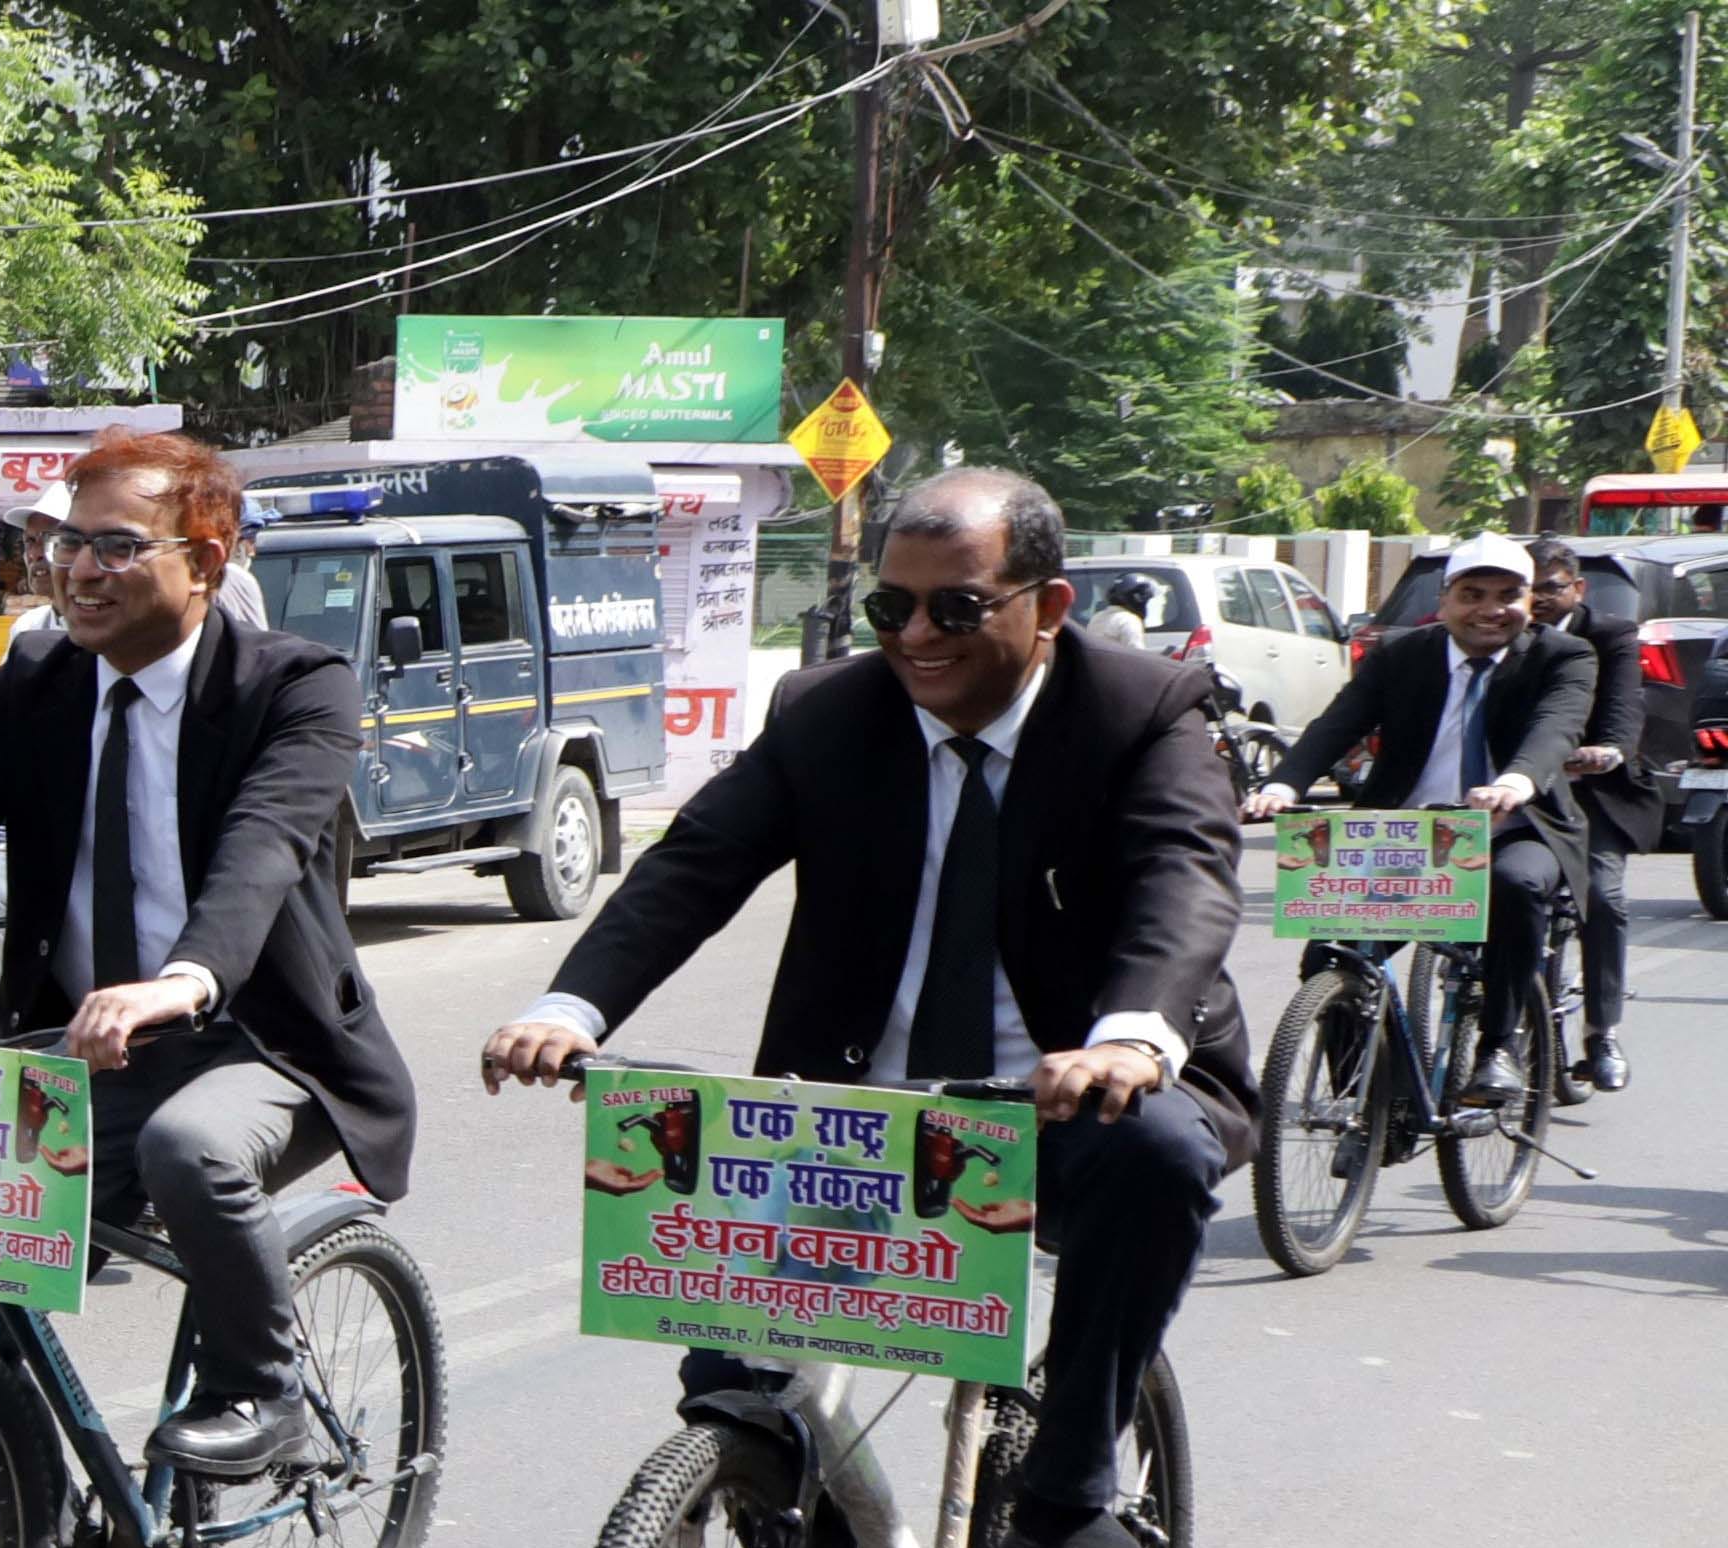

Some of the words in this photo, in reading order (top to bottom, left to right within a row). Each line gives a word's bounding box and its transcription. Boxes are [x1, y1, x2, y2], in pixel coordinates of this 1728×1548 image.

[641, 342, 712, 366] Amul
[613, 373, 726, 401] MASTI
[652, 409, 733, 421] BUTTERMILK
[1345, 821, 1376, 839] एक
[1336, 848, 1366, 867] एक
[602, 1091, 643, 1107] SAVE
[649, 1088, 691, 1103] FUEL
[729, 1100, 799, 1142] एक
[812, 1106, 890, 1159] राष्ट्र
[926, 1110, 969, 1131] SAVE
[975, 1120, 1020, 1143] FUEL
[709, 1156, 774, 1199] एक
[787, 1152, 905, 1214] संकल्प
[5, 1230, 74, 1269] बनाओ
[788, 1227, 962, 1281] बचाओ
[600, 1256, 671, 1297] हरित
[680, 1264, 727, 1302] एवं
[729, 1275, 832, 1324] मज़बूत
[838, 1287, 904, 1330] राष्ट्र
[905, 1294, 1011, 1338] बनाओ
[768, 1327, 805, 1349] जिला
[884, 1345, 944, 1367] लखनऊ
